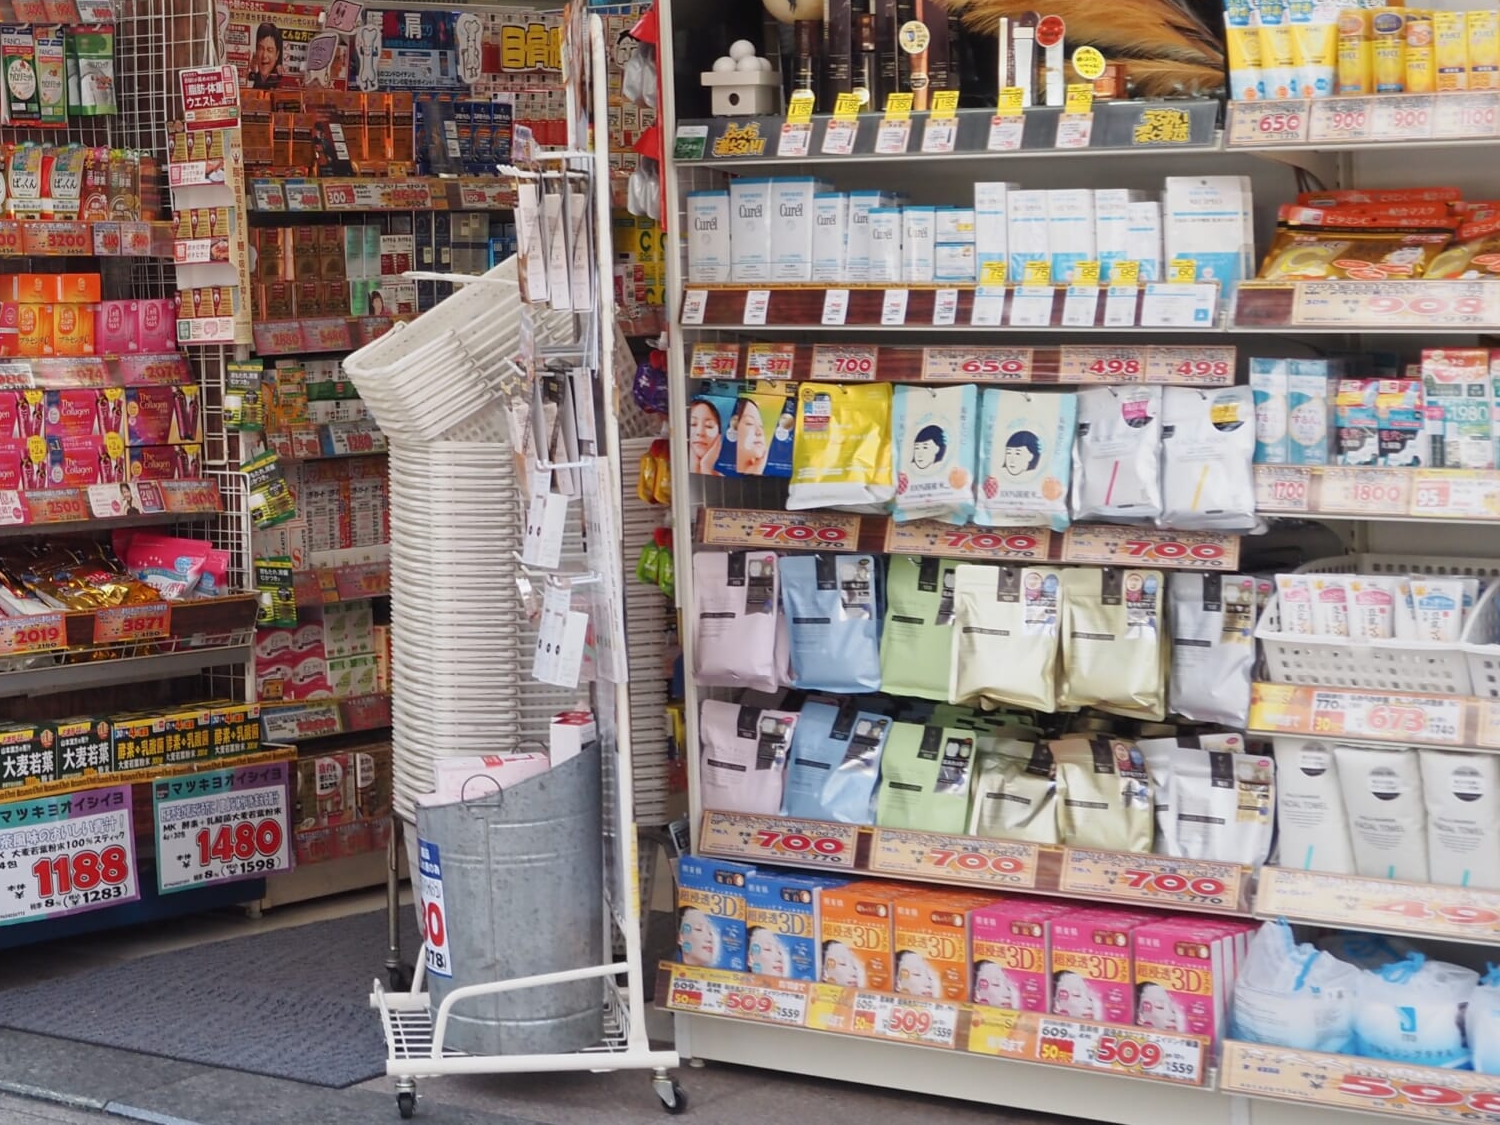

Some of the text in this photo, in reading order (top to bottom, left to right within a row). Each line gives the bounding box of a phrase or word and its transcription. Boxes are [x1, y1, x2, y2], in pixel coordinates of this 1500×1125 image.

[403, 12, 422, 39] 肩
[1259, 113, 1300, 132] 650
[1332, 111, 1366, 130] 900
[328, 191, 346, 204] 300
[1367, 296, 1486, 316] 908
[711, 357, 738, 371] 371
[834, 357, 872, 373] 700
[961, 359, 1024, 374] 650
[1089, 359, 1141, 375] 498
[1176, 360, 1229, 376] 498
[61, 406, 92, 419] Collagen
[1273, 482, 1306, 500] 1700
[49, 501, 80, 514] 2500
[758, 523, 848, 542] 700
[945, 531, 1038, 550] 700
[815, 540, 844, 549] 770
[1125, 540, 1226, 560] 700
[122, 615, 165, 632] 3871
[17, 628, 61, 645] 2019
[1366, 707, 1426, 732] 673
[3, 750, 54, 780] 大麦若葉
[62, 741, 110, 771] 大麦若葉
[171, 767, 283, 795] マツキヨオイシイヨ
[0, 791, 124, 823] マツキヨオイシイヨ
[195, 817, 283, 867] 1480
[755, 830, 845, 854] 700
[240, 857, 275, 874] 1598
[931, 848, 1024, 874] 700
[32, 844, 129, 899] 1188
[1124, 869, 1226, 895] 700
[82, 885, 122, 904] 1283
[724, 993, 774, 1012] 509
[780, 1009, 800, 1019] 559
[1097, 1036, 1163, 1068] 509
